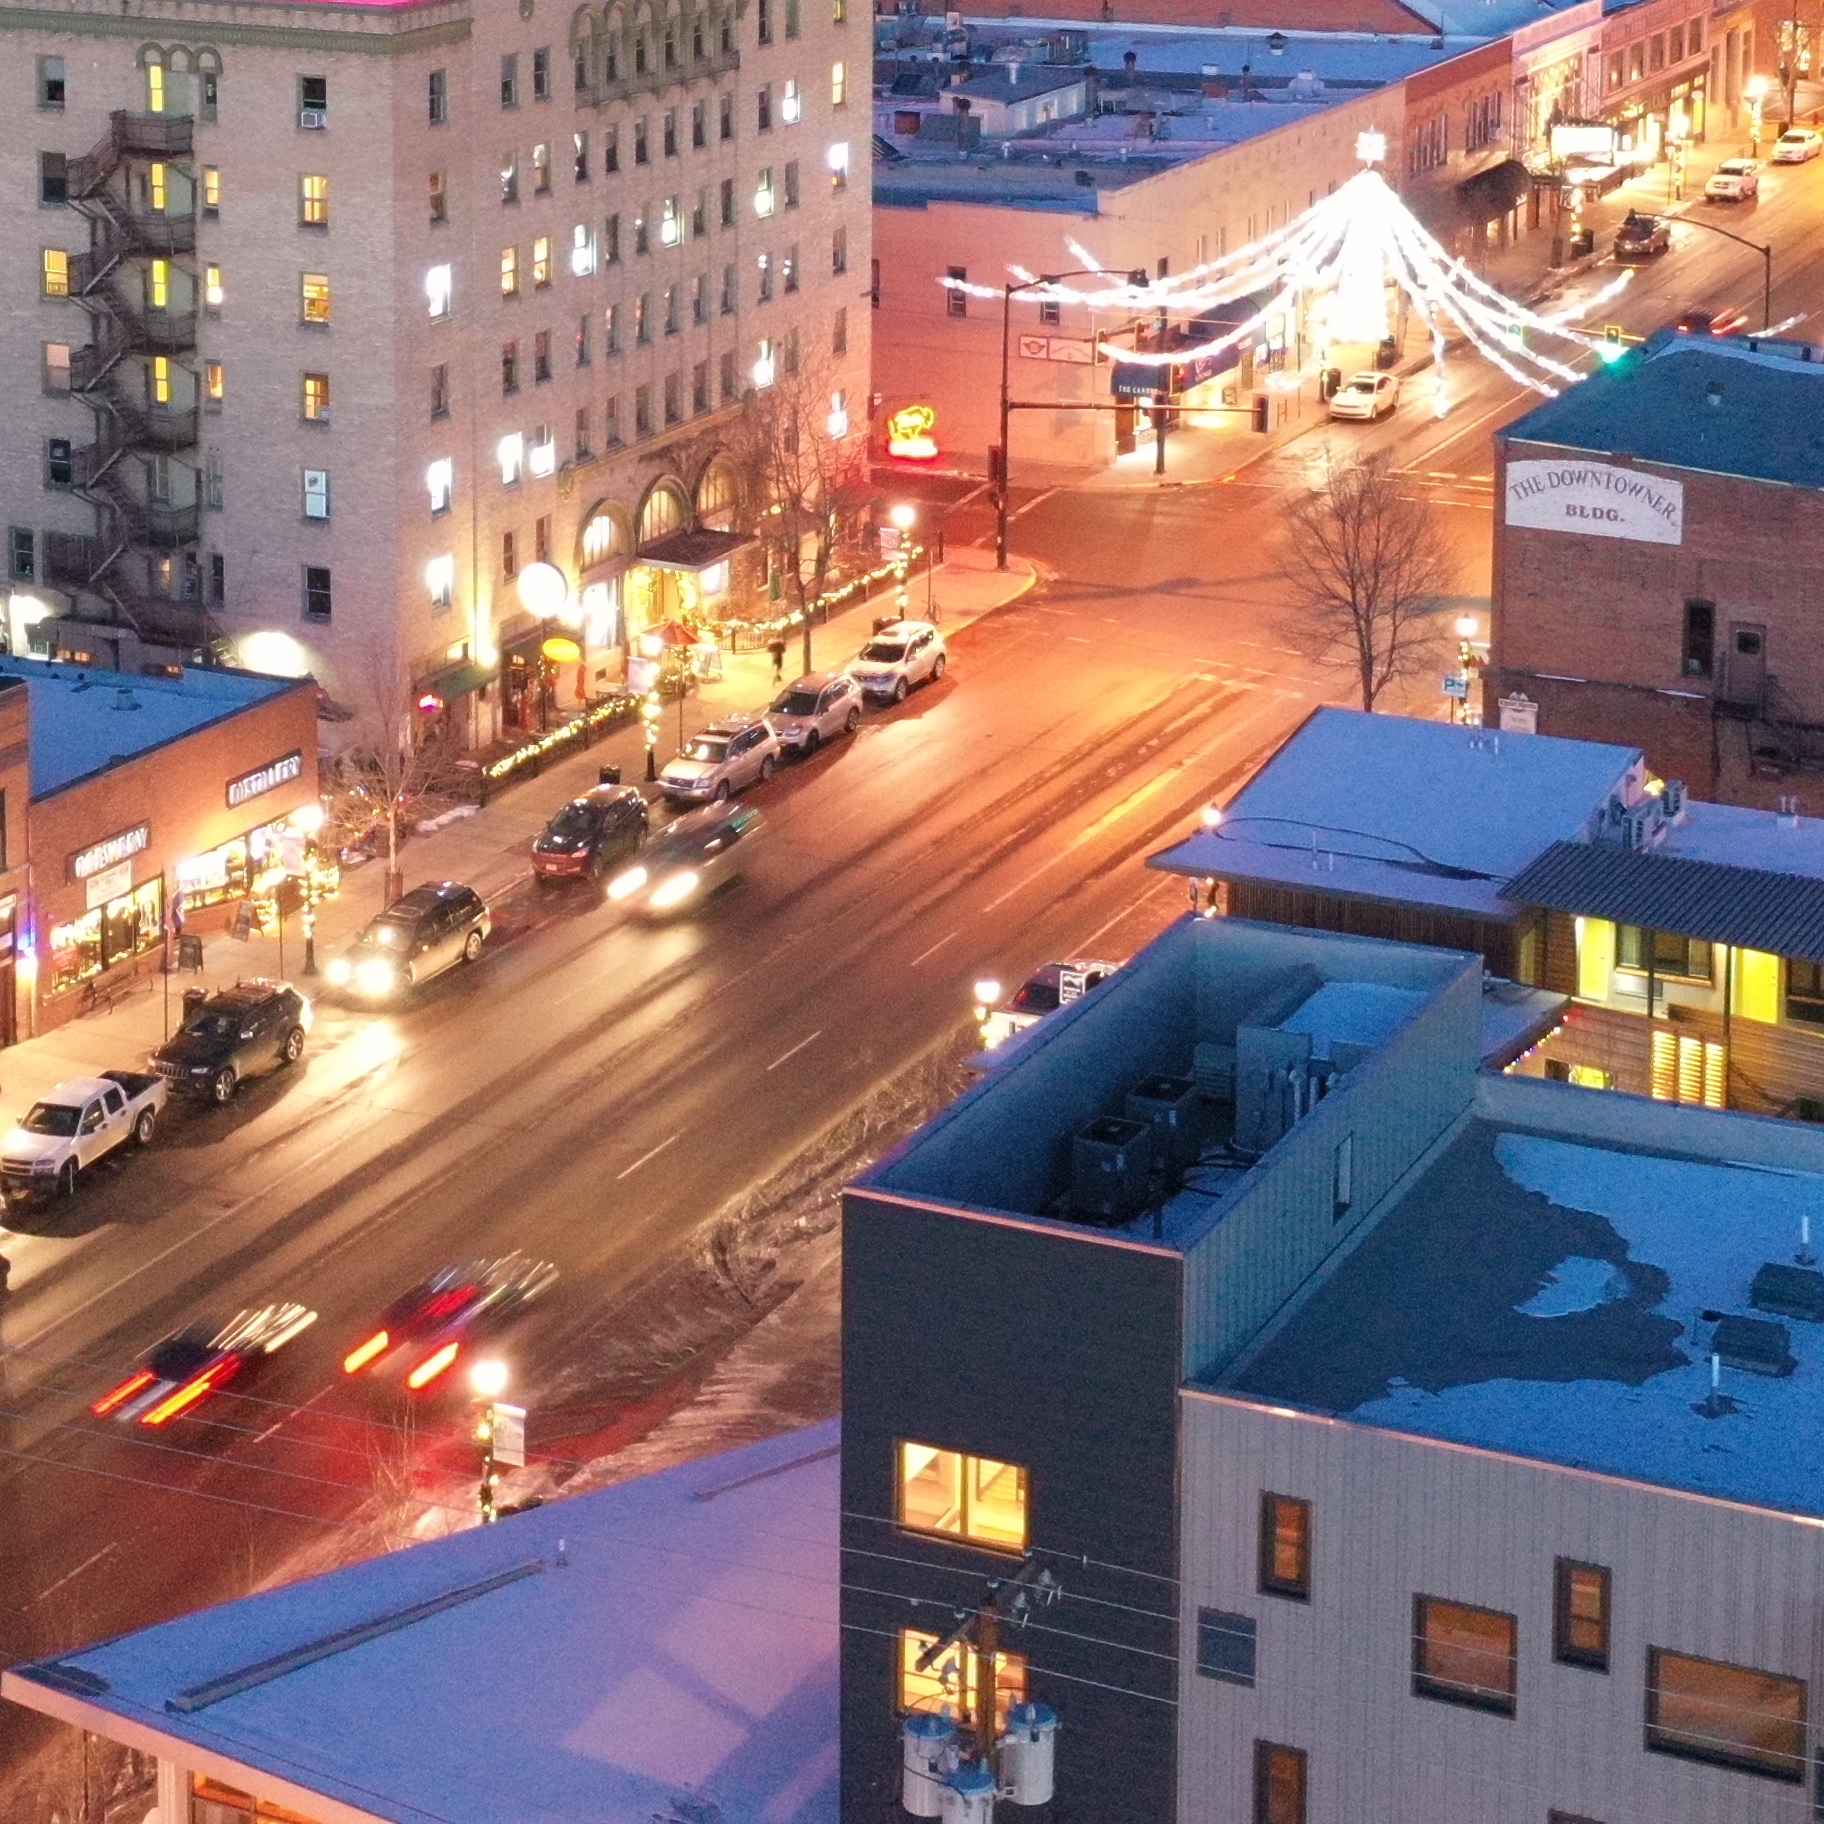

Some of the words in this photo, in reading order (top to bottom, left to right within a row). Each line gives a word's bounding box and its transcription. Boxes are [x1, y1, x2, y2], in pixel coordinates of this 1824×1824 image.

[1509, 473, 1545, 501] THE
[1549, 470, 1678, 521] DOWNTOWNER
[1565, 503, 1625, 523] BLDG.
